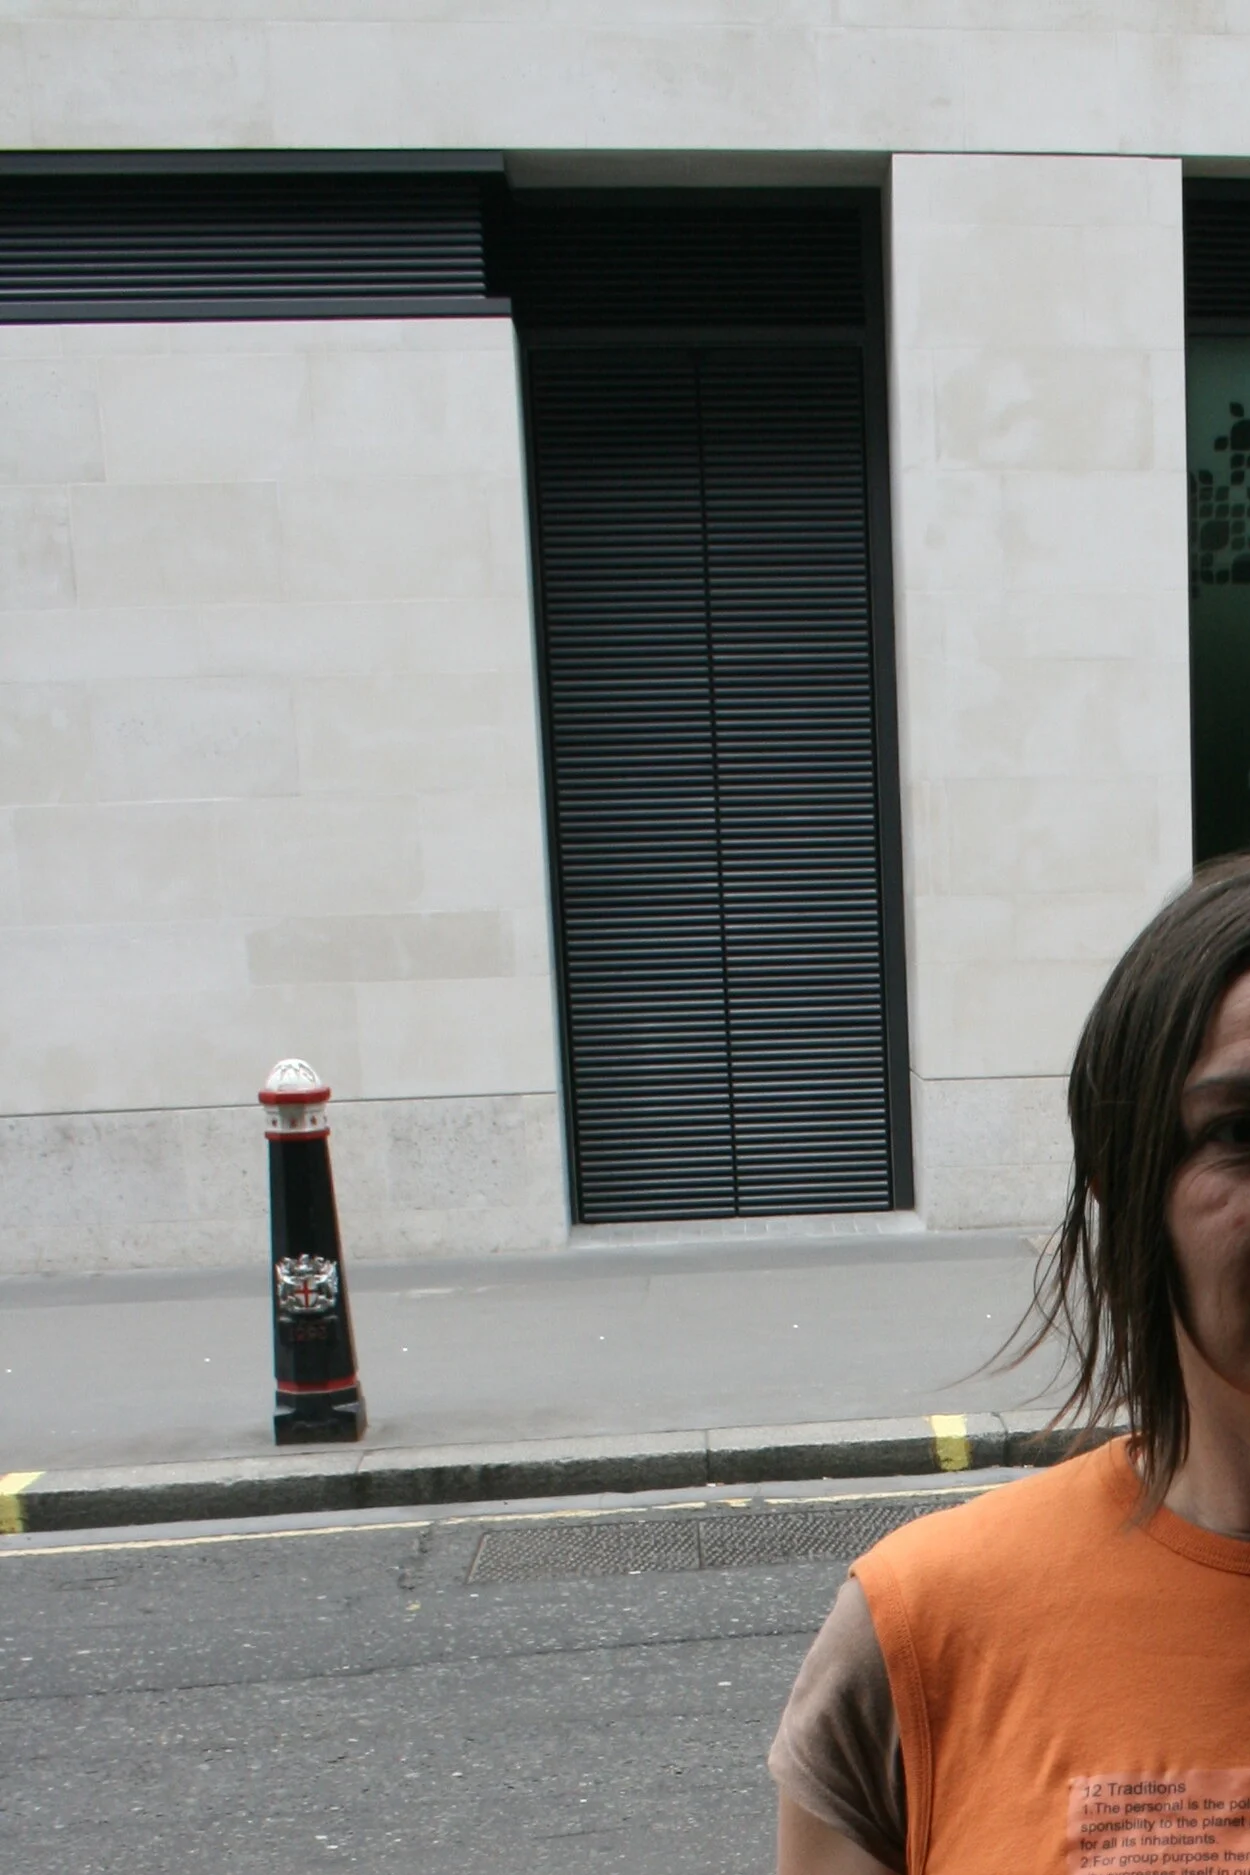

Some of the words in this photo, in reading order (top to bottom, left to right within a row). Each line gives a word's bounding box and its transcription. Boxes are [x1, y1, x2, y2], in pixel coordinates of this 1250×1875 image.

[1084, 1783, 1101, 1797] 12
[1108, 1781, 1186, 1796] Traditions
[1125, 1799, 1183, 1816] personal
[1188, 1798, 1198, 1810] is
[1203, 1798, 1224, 1809] the
[1081, 1817, 1154, 1835] sponsibility
[1160, 1816, 1173, 1827] to
[1177, 1815, 1198, 1827] the
[1202, 1815, 1245, 1830] planet
[1081, 1837, 1097, 1849] for
[1102, 1836, 1117, 1848] all
[1122, 1835, 1136, 1847] its
[1119, 1853, 1158, 1867] group
[1163, 1852, 1219, 1865] purpose
